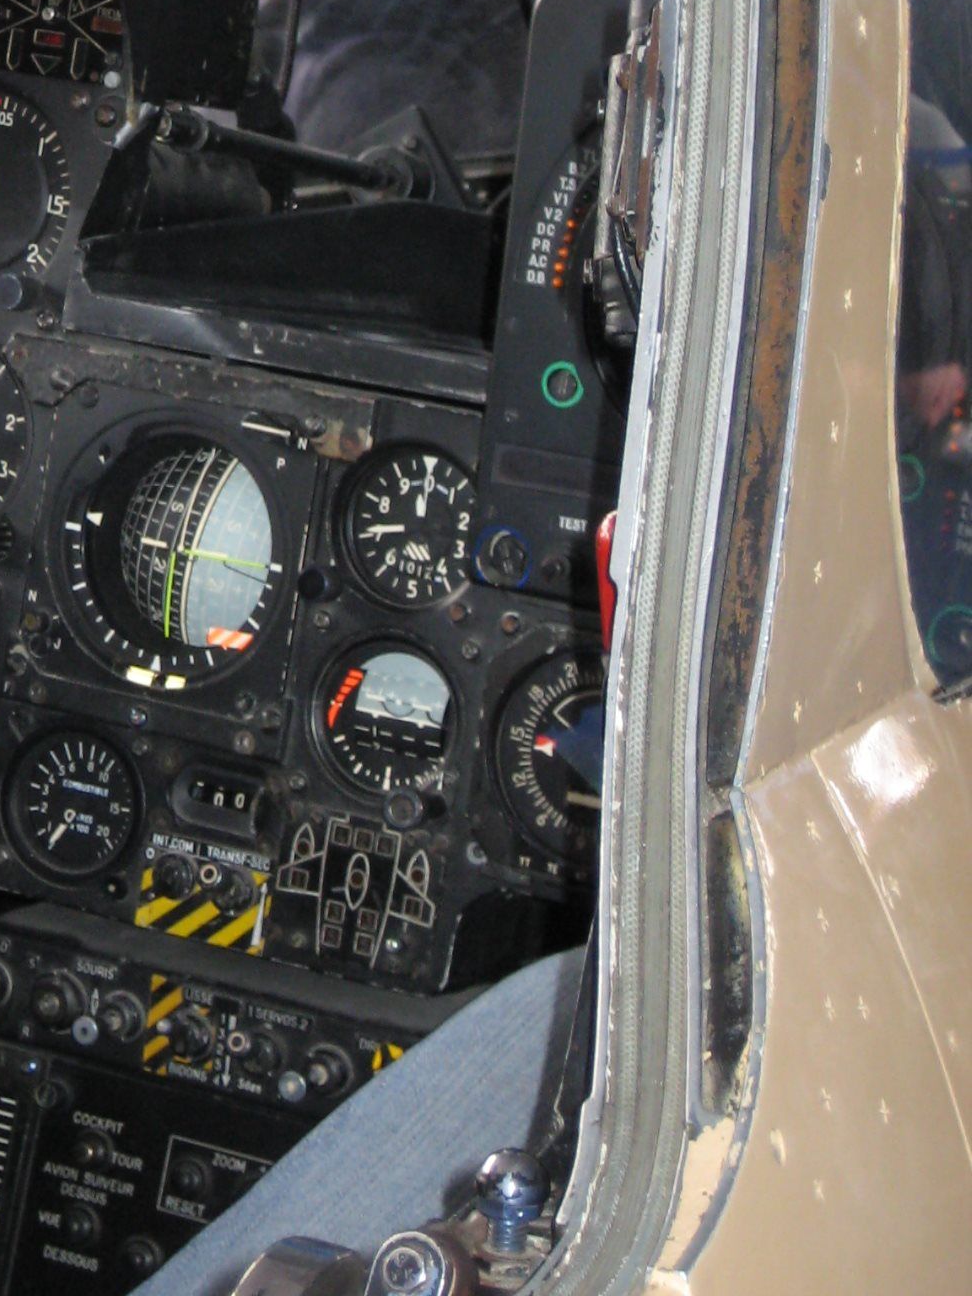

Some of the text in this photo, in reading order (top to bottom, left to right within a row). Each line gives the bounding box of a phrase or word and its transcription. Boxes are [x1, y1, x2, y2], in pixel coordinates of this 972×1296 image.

[553, 191, 569, 207] V1
[543, 207, 563, 223] V2
[26, 243, 41, 264] 2
[5, 413, 16, 432] 2
[399, 477, 410, 496] 9
[378, 495, 391, 515] 8
[458, 511, 470, 531] 2
[558, 514, 588, 533] TEST
[384, 546, 397, 566] 6
[452, 539, 465, 560] 3
[436, 557, 447, 575] 4
[406, 580, 418, 599] 5
[72, 1110, 125, 1135] COCKPIT
[112, 1150, 145, 1172] TOUR
[211, 1152, 247, 1174] ZOOM
[42, 1161, 135, 1197] AVION SUIVEUR
[59, 1181, 108, 1207] DESSUS
[42, 1243, 100, 1273] DESSOUS
